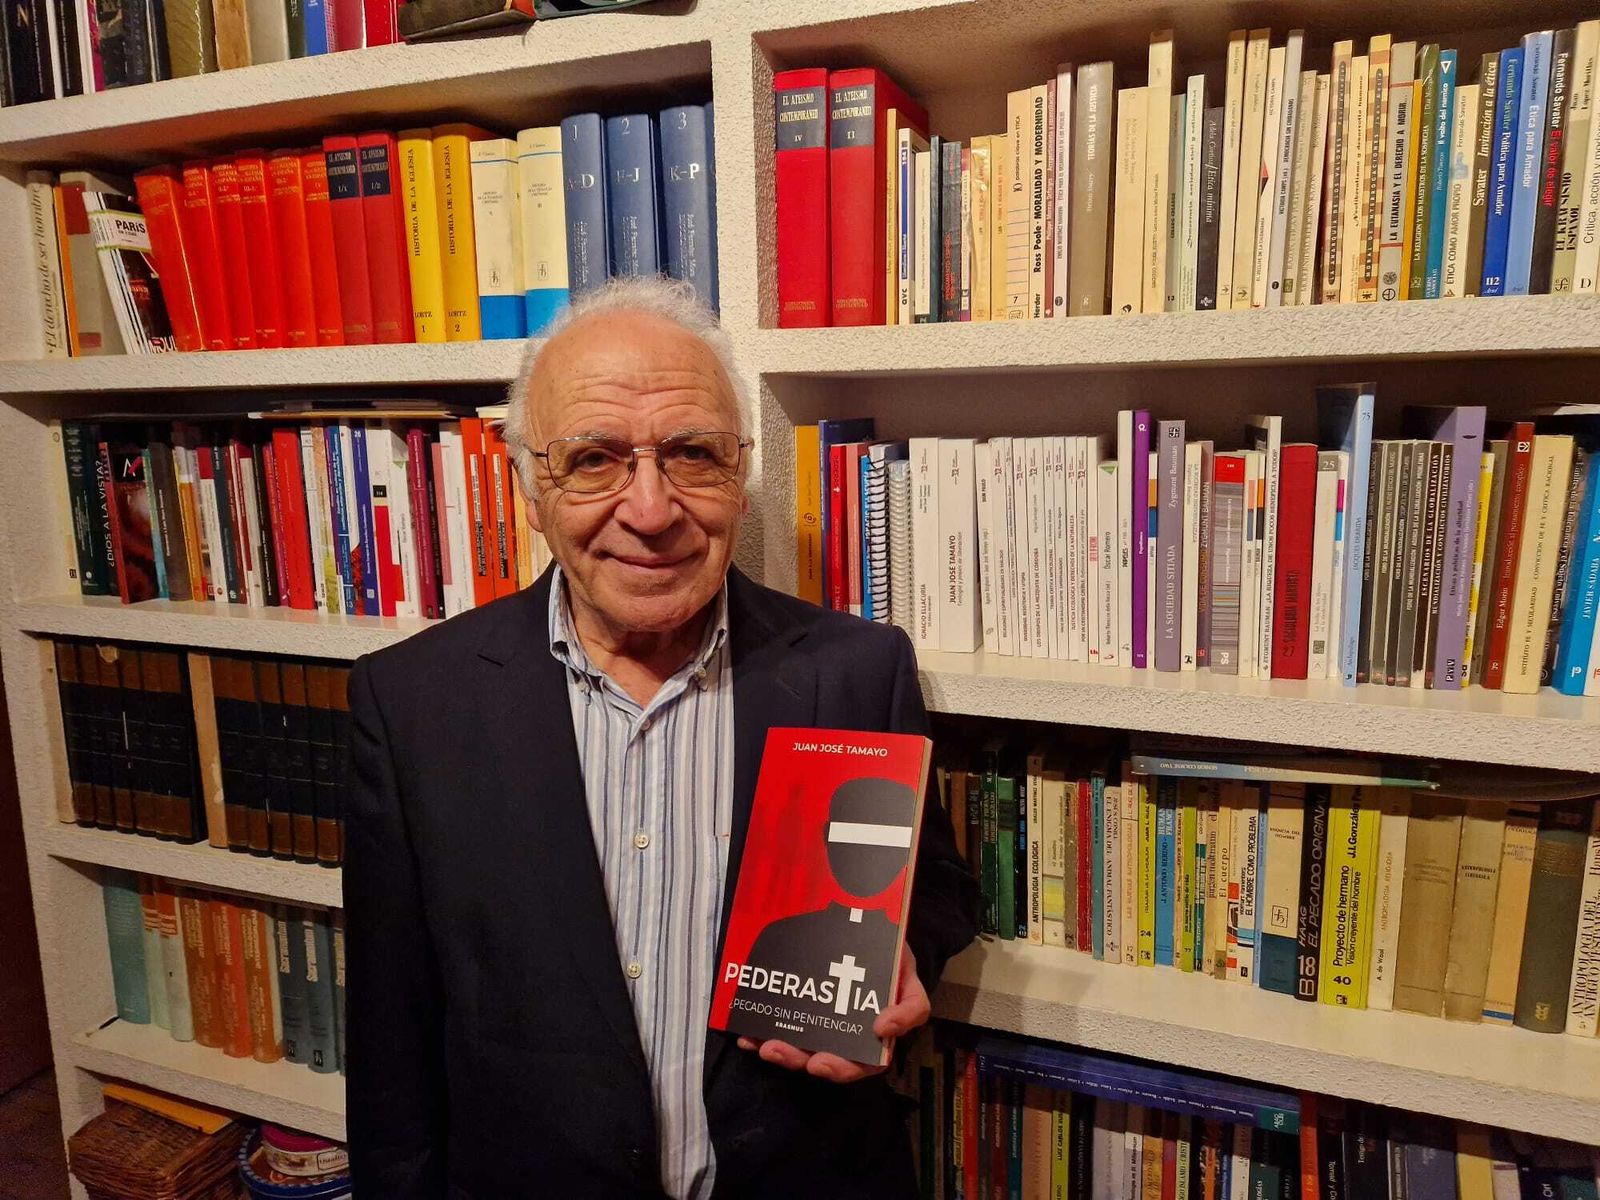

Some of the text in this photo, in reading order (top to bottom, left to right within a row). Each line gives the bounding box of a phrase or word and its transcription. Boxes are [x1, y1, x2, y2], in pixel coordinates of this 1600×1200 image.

[1484, 62, 1497, 85] ética
[783, 93, 814, 105] EL ATEISMO
[835, 91, 867, 103] EL ATEISMO
[1483, 87, 1494, 97] la
[678, 112, 687, 130] 3
[1397, 95, 1407, 125] MORIR...
[572, 125, 578, 141] 1
[621, 118, 631, 135] 2
[1035, 97, 1043, 155] MODERNIDAD
[1419, 124, 1429, 155] SOSPECHA
[1456, 120, 1465, 147] Fernando
[1477, 109, 1493, 157] Invitación
[1494, 58, 1517, 216] Fernando Savater Política para Amador
[1542, 53, 1568, 206] Fernando Savater El valor de elegir
[1394, 138, 1404, 169] DERECHO
[1419, 156, 1426, 164] LA
[670, 162, 700, 181] K-P
[1393, 172, 1401, 180] EL
[1418, 165, 1426, 173] DE
[446, 183, 452, 195] LA
[1034, 169, 1042, 219] MORALIDAD
[1417, 174, 1426, 203] MAESTROS
[1451, 183, 1461, 210] PROPIO
[1472, 168, 1487, 206] Savater
[407, 149, 420, 256] HISTORIA DE LA IGLESIA
[447, 197, 453, 210] DE
[1390, 190, 1400, 228] EUTANASIA
[1555, 173, 1572, 251] EL KRAUSISMO
[1583, 172, 1600, 244] Crítica, acción
[447, 214, 456, 255] HISTORIA
[1389, 232, 1398, 241] LA
[1449, 212, 1459, 235] AMOR
[1034, 226, 1042, 250] Poole
[1414, 224, 1423, 252] RELIGION
[1447, 237, 1457, 261] COMO
[1034, 253, 1042, 273] Ross
[1414, 253, 1421, 261] LA
[1445, 263, 1456, 284] ÉTICA
[1485, 276, 1500, 285] 112
[421, 325, 426, 333] 1
[455, 324, 461, 333] 2
[1322, 461, 1335, 469] 25
[1440, 454, 1451, 508] CIVILIZATORIOS
[95, 460, 115, 567] ¿DIOS A LA VISTA?
[1268, 515, 1276, 535] POCOS
[1421, 454, 1440, 597] ESCENARIOS DE LA GLOBALIZACIÓN
[1165, 445, 1178, 639] LA SOCIEDAD SITIADA Zygmunt Bauman
[1201, 514, 1209, 548] ZYGMUNT
[1436, 509, 1448, 550] CONFLICTOS
[1352, 517, 1362, 571] JACQUES DERRIDA
[1267, 555, 1273, 564] DE
[949, 584, 957, 603] JUAN
[1200, 587, 1206, 595] DE
[1431, 559, 1443, 615] MUNDIALIZACIÓN
[1582, 557, 1600, 619] JAVIER SÁDABA
[1220, 652, 1229, 665] PS
[793, 742, 888, 757] JUAN JOSÉ TAMAYO
[1106, 796, 1112, 807] EL
[1220, 847, 1228, 897] El cuerpo
[1246, 816, 1256, 916] EL HOMBRE COMO PROBLEMA
[1106, 889, 1114, 936] FANTÁSTICO
[1332, 865, 1350, 966] Proyecto de hermano
[1346, 871, 1361, 965] Visión creyente del hombre
[1298, 906, 1307, 948] HAAG
[1298, 955, 1316, 976] 18
[1572, 896, 1597, 1018] ANTROPOLOGIA DEL
[725, 954, 881, 1015] PEDERASTIA
[1299, 979, 1315, 996] B
[1333, 975, 1352, 985] 40
[729, 998, 863, 1034] ¿PECADO SIN PENITENCIA?
[775, 1021, 804, 1032] ERASMUS
